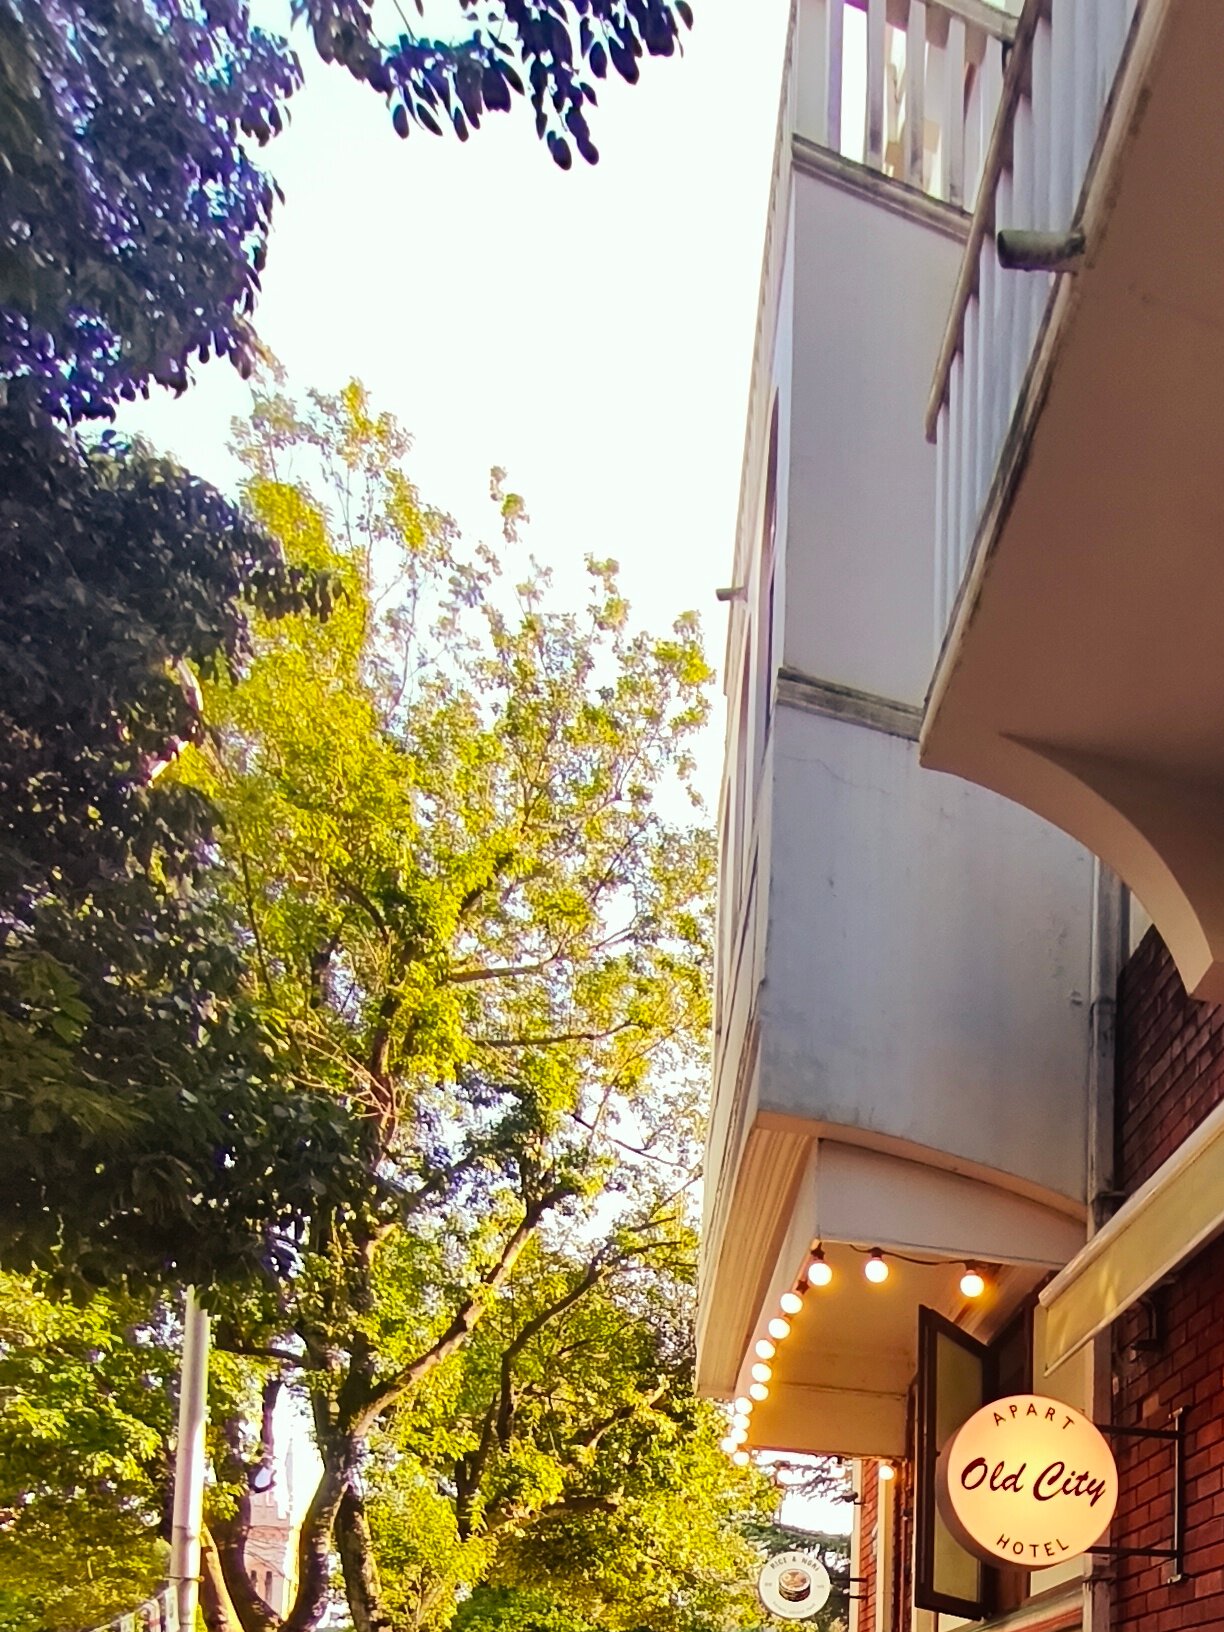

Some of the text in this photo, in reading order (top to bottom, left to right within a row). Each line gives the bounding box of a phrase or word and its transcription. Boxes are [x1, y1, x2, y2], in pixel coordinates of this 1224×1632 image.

[992, 1402, 1075, 1431] APART
[960, 1456, 1106, 1507] Old City
[996, 1533, 1070, 1558] HOTEL
